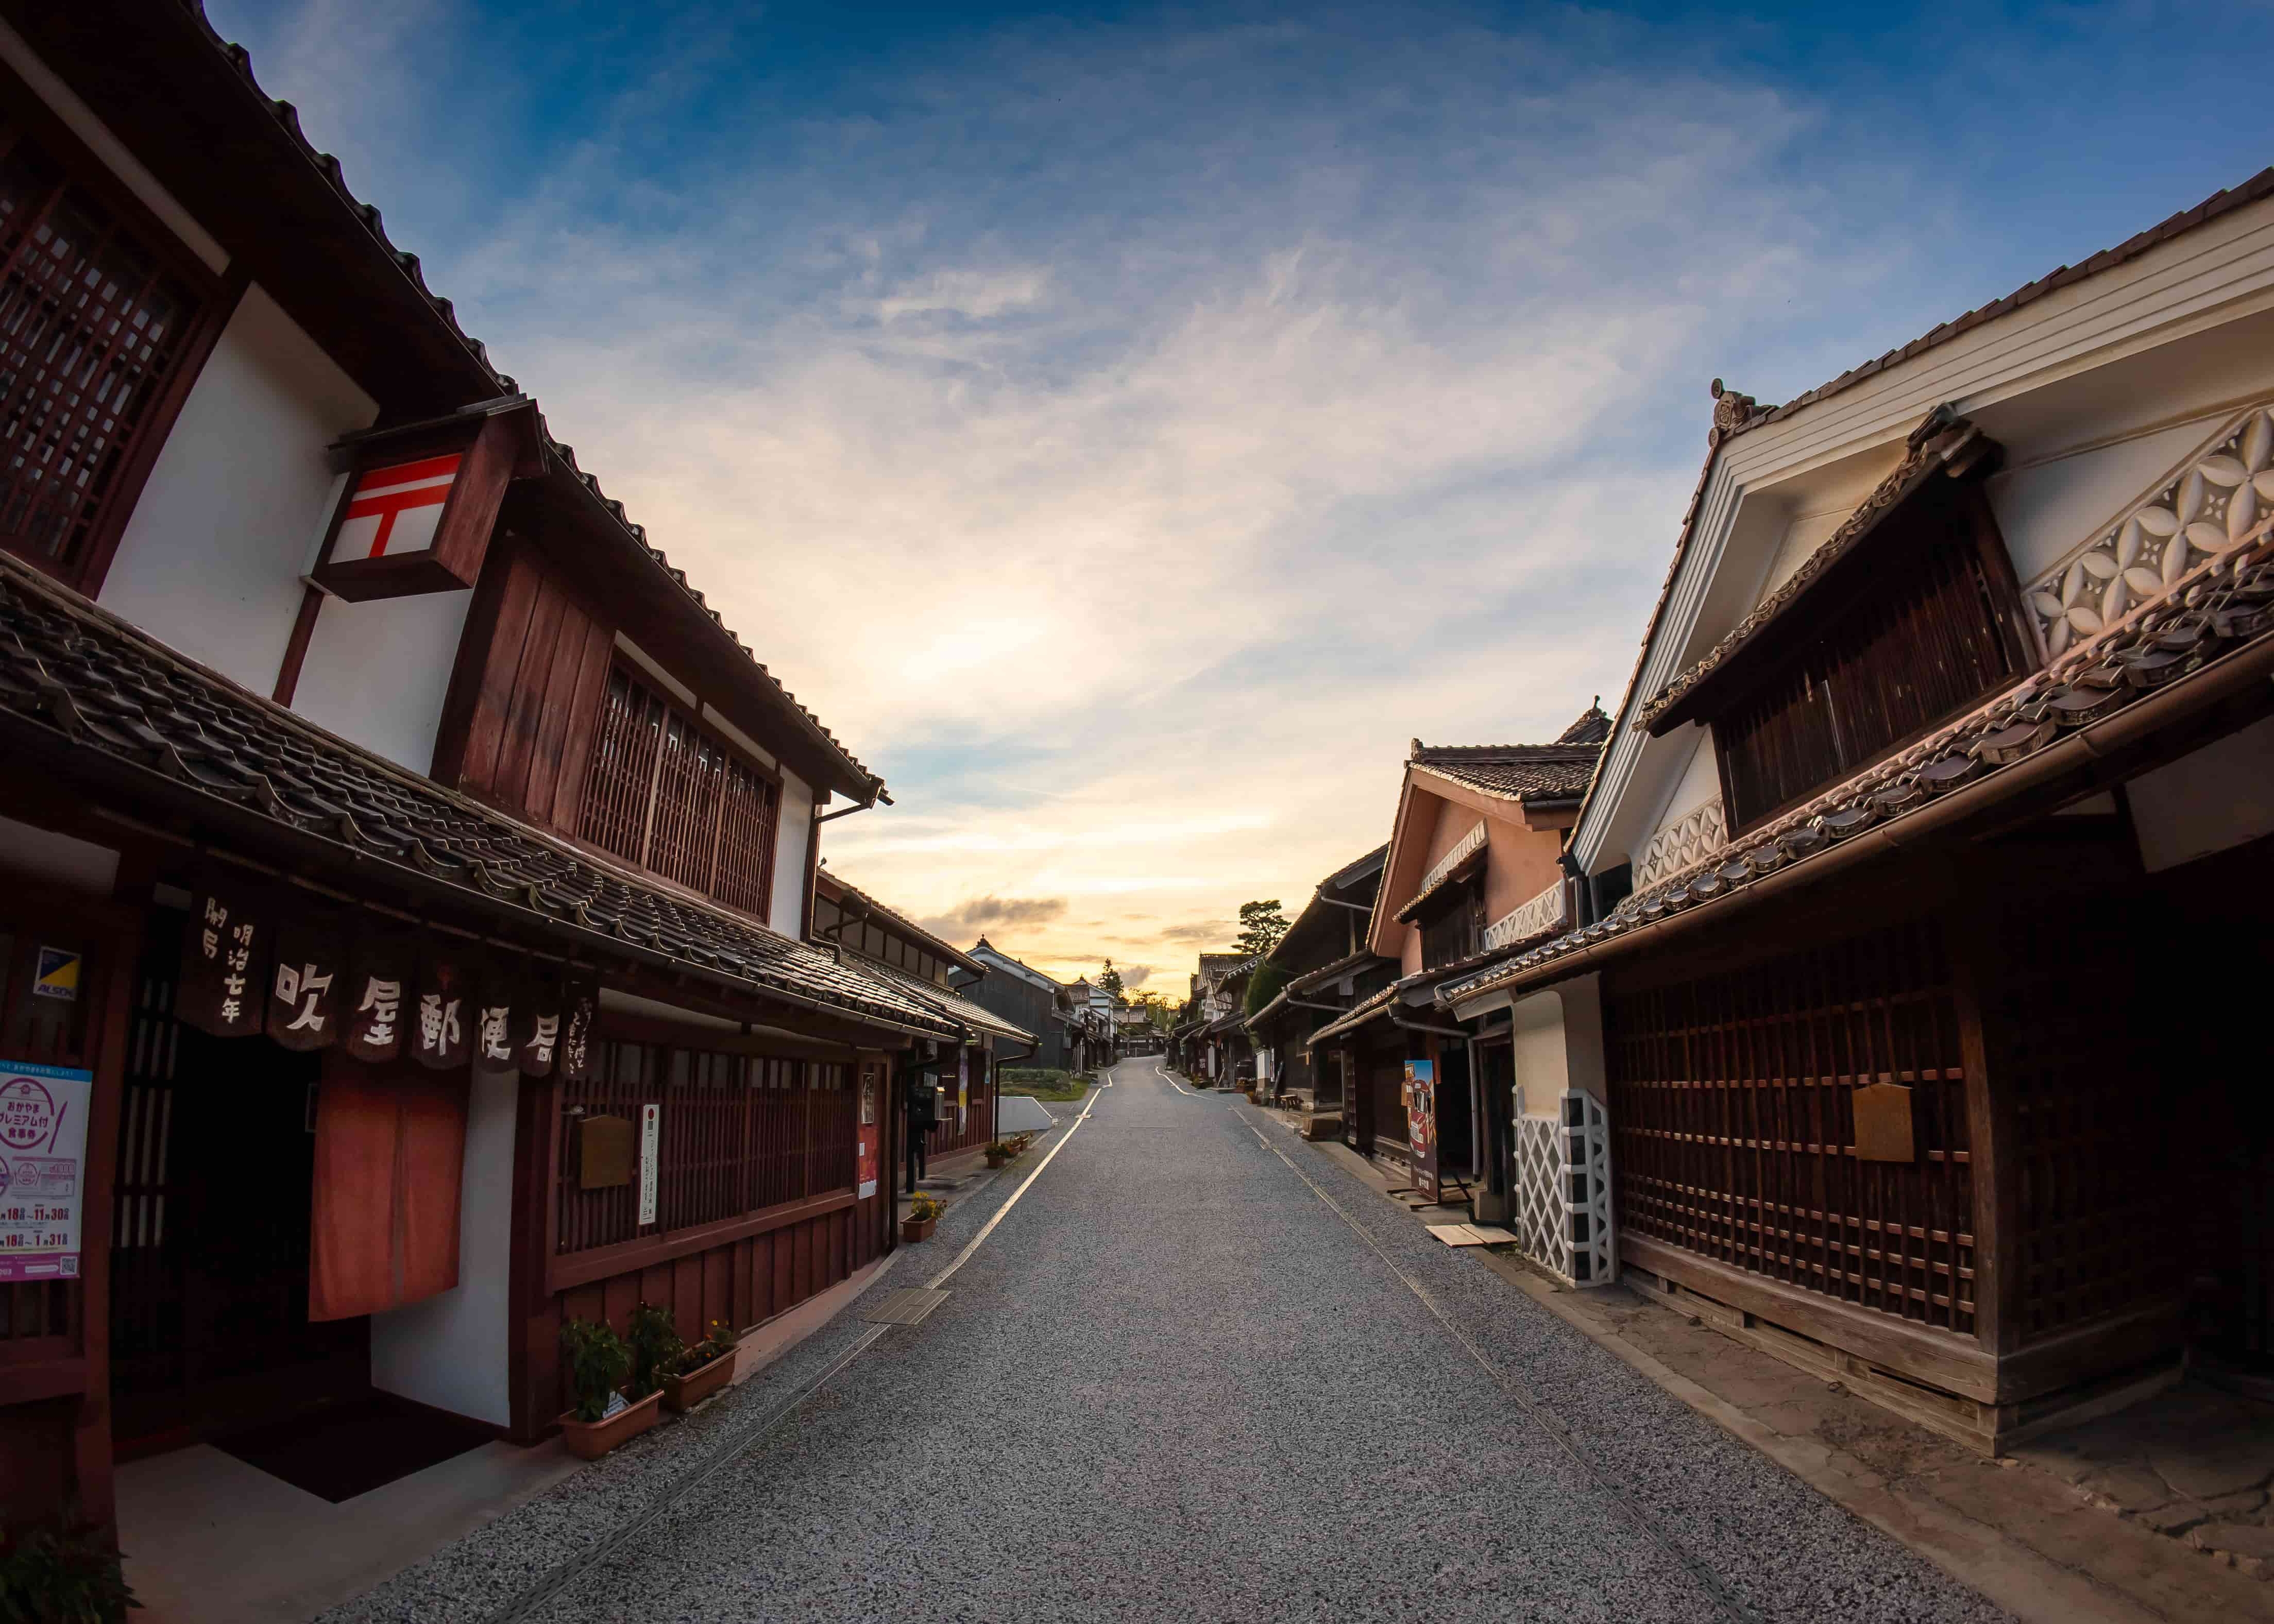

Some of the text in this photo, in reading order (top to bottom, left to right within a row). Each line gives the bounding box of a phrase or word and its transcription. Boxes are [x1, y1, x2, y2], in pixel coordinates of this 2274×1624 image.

[222, 924, 254, 1024] 明治七年
[7, 1101, 40, 1114] おかやま
